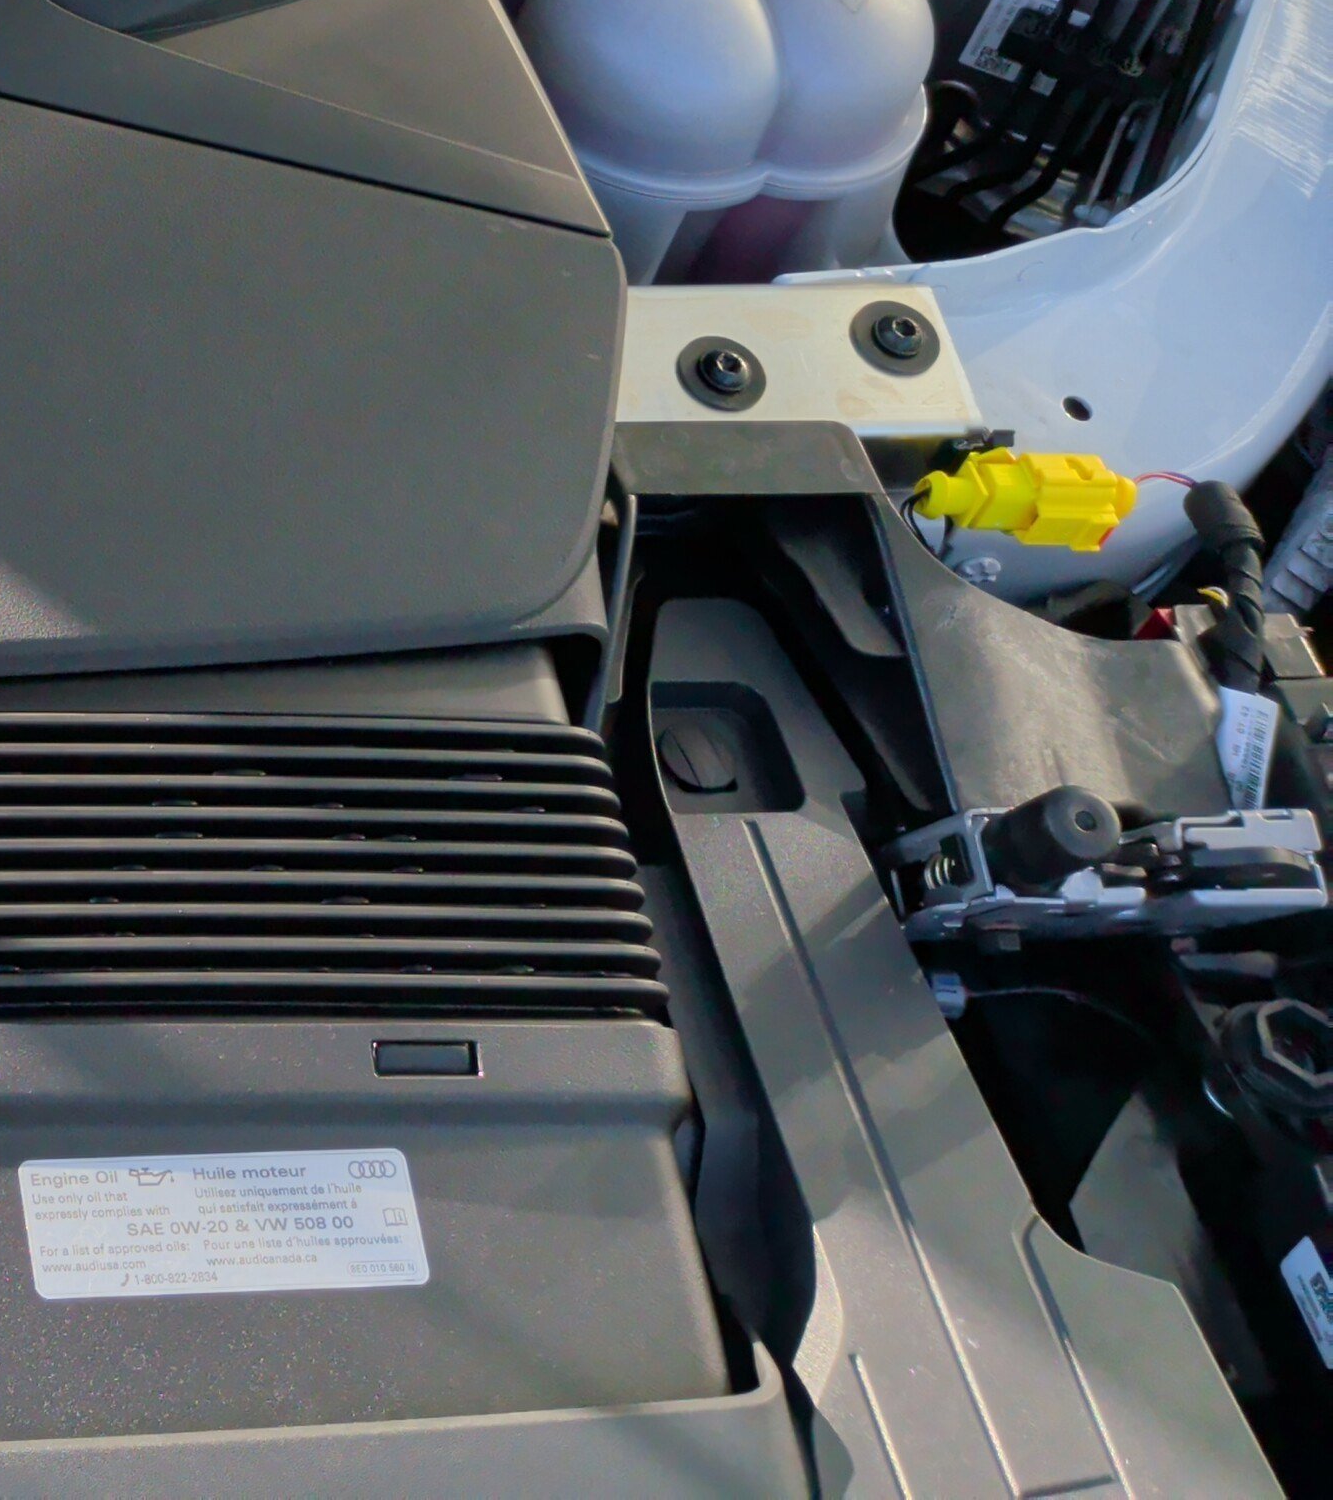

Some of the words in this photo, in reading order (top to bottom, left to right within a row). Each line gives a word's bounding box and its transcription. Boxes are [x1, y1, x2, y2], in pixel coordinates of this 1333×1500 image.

[31, 1173, 89, 1188] Engine
[95, 1170, 118, 1183] Oil
[192, 1167, 236, 1180] Huile
[242, 1166, 306, 1179] moteur
[195, 1187, 237, 1198] Utilisez
[240, 1186, 308, 1199] uniquement
[311, 1184, 325, 1194] de
[327, 1183, 362, 1194] l'huile
[33, 1193, 55, 1205] Use
[58, 1193, 83, 1205] only
[87, 1192, 101, 1203] oil
[104, 1192, 128, 1202] that
[35, 1208, 88, 1221] expressly
[92, 1206, 142, 1219] complies
[146, 1205, 170, 1216] with
[198, 1203, 216, 1215] qui
[219, 1201, 264, 1213] satisfait
[127, 1222, 164, 1236] SAE
[170, 1220, 229, 1236] 0W-20
[236, 1220, 249, 1232] &
[255, 1218, 288, 1232] VW
[294, 1216, 326, 1230] 508
[332, 1216, 354, 1229] 00
[40, 1246, 58, 1256] For
[62, 1248, 69, 1256] a
[72, 1244, 89, 1255] list
[93, 1244, 105, 1254] of
[108, 1242, 163, 1255] approved
[204, 1240, 231, 1251] Pour
[234, 1240, 255, 1250] une
[258, 1237, 283, 1248] liste
[42, 1259, 146, 1273] www.audiusa.com
